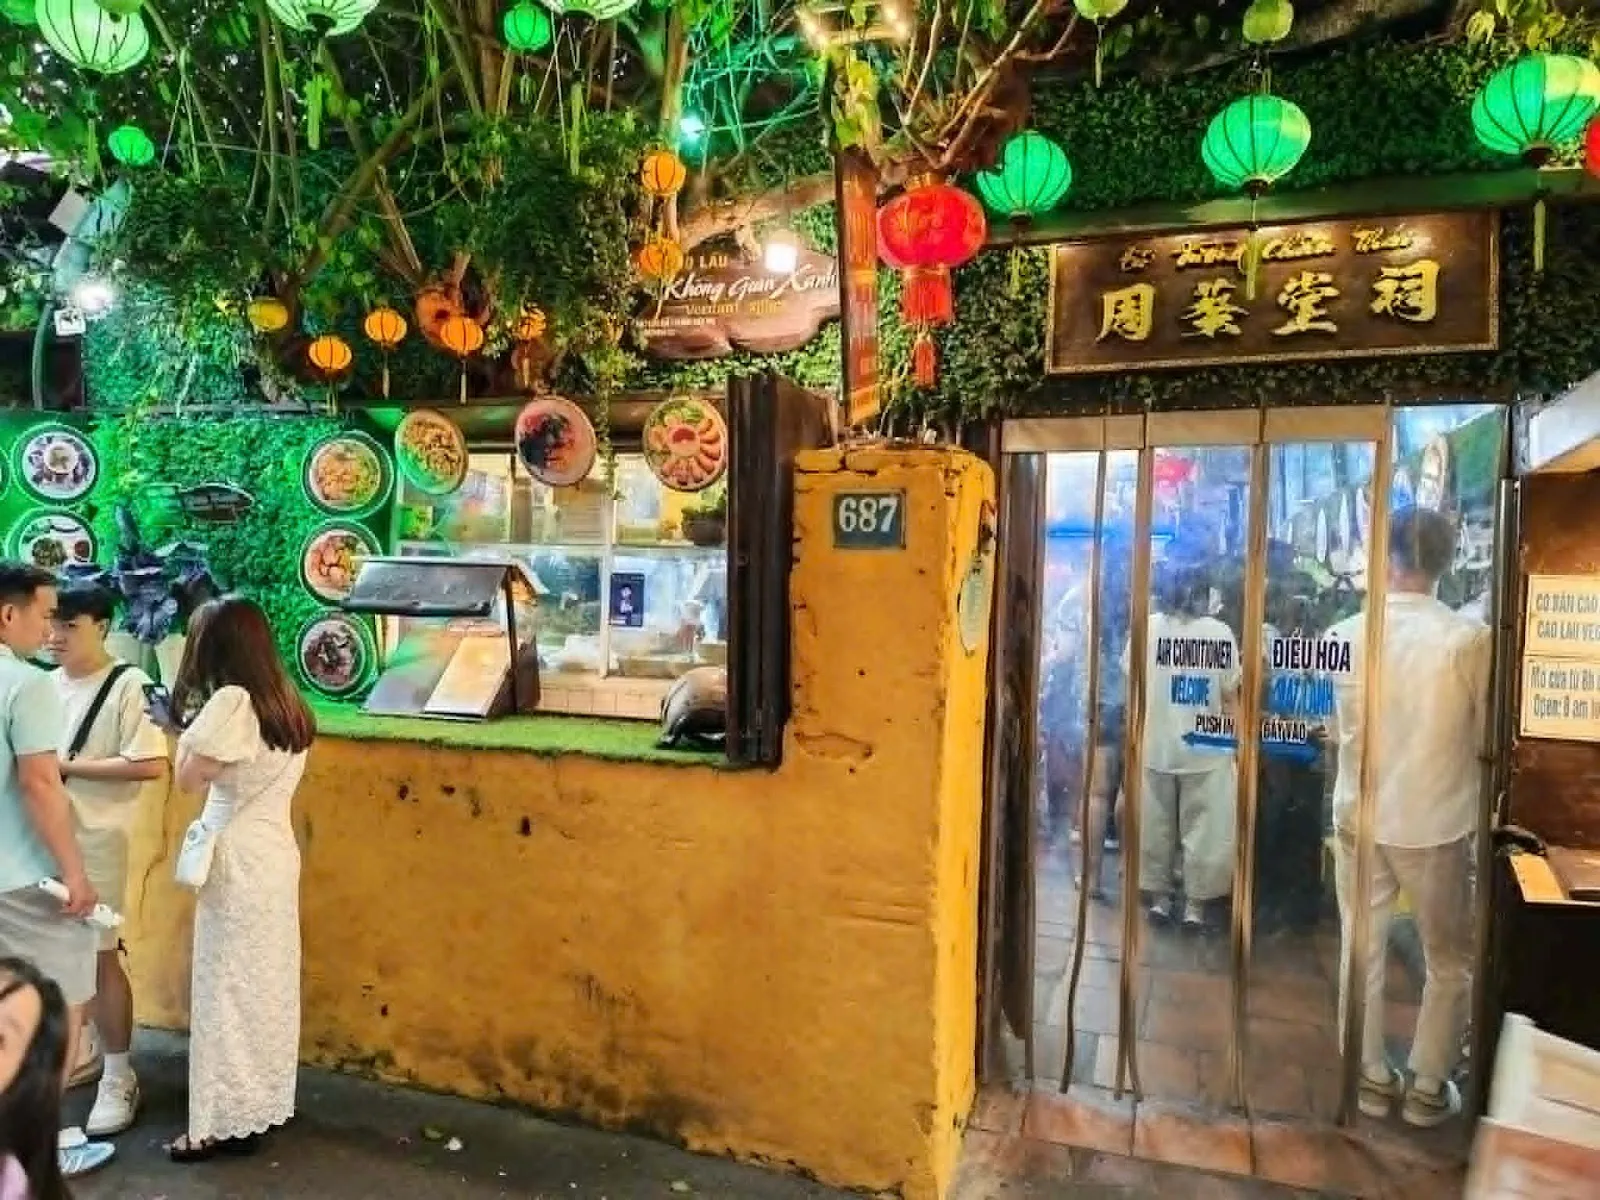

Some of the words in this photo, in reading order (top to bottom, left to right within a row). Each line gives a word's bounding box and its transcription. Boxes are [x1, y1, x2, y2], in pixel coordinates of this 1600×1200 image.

[838, 496, 898, 533] 687
[1156, 637, 1171, 667] AIR
[1173, 638, 1232, 669] CONDITIONER
[1195, 713, 1222, 734] PUSH
